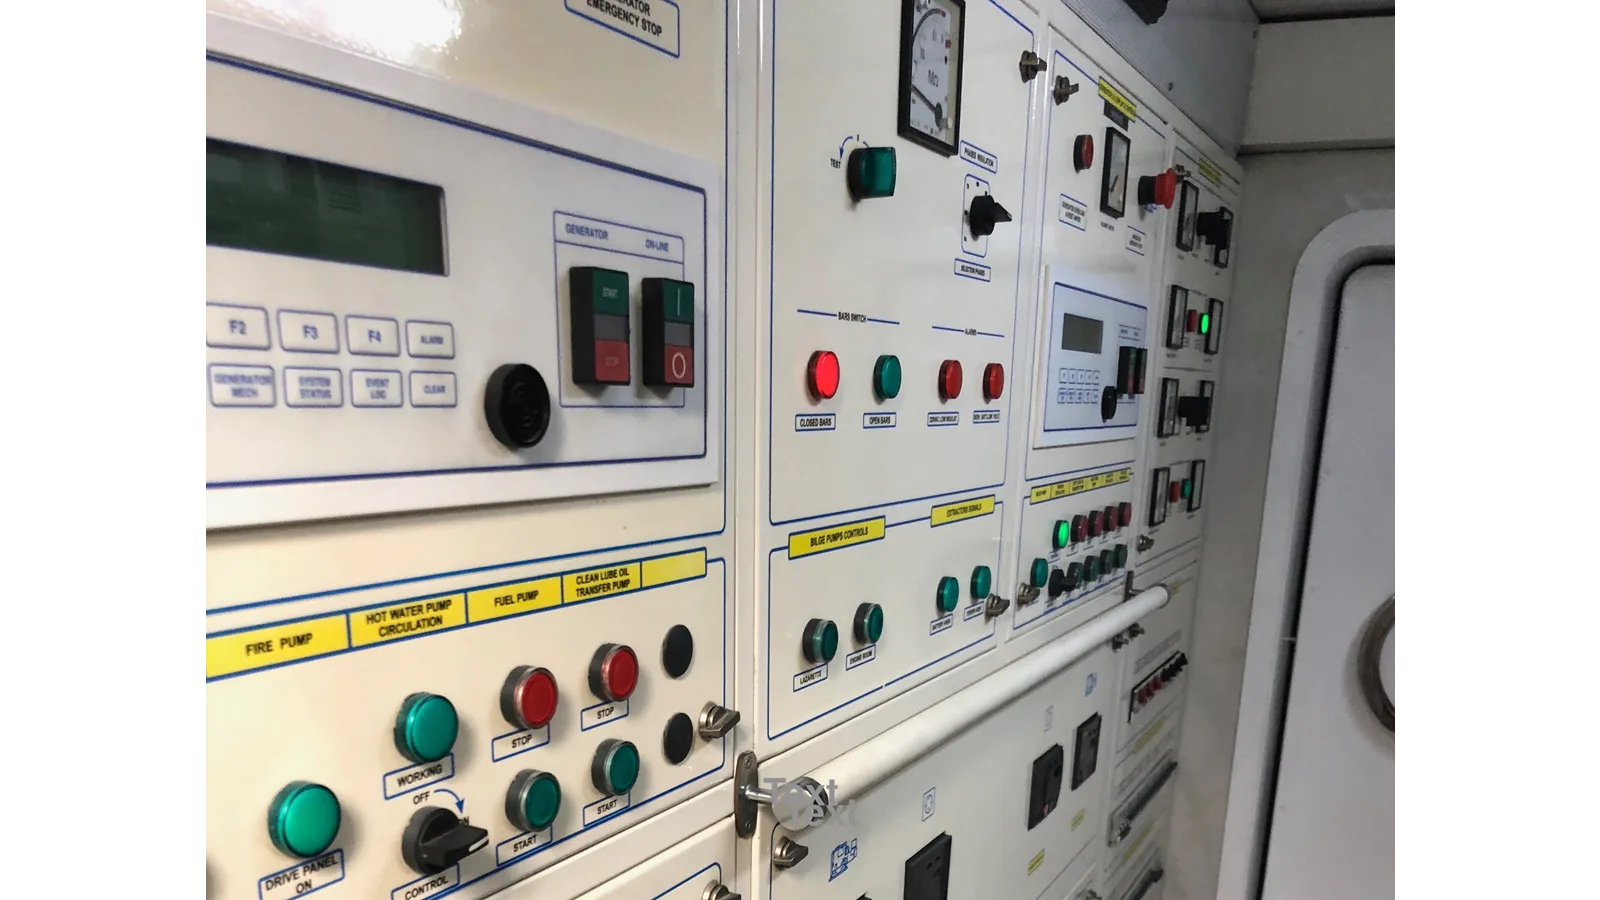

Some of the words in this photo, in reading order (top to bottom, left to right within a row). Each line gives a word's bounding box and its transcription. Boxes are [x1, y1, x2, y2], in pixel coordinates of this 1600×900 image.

[641, 18, 662, 37] STOP
[830, 158, 841, 169] TEST
[565, 223, 608, 239] GENERATOR
[645, 239, 669, 252] ON-LINE
[838, 311, 850, 321] BARS
[851, 313, 866, 323] SWITCH
[229, 319, 247, 335] F2
[302, 325, 318, 340] F3
[368, 329, 382, 344] F4
[366, 378, 389, 388] EVENT
[424, 385, 446, 394] CLEAR
[371, 390, 386, 399] LOG
[800, 418, 819, 428] CLOSED
[819, 417, 831, 426] BARS
[869, 416, 880, 425] OPEN
[880, 415, 891, 424] BARS
[810, 536, 825, 547] BILGE
[826, 533, 843, 544] PUMPS
[844, 526, 869, 540] CONTROLS
[576, 573, 599, 585] CLEAN
[600, 570, 617, 581] LUBE
[619, 567, 630, 577] OIL
[575, 582, 611, 598] TRANSFER
[612, 579, 630, 590] PUMP
[494, 595, 514, 607] FUEL
[516, 590, 539, 603] PUMP
[366, 610, 387, 625] HOT
[390, 605, 424, 620] WATER
[426, 599, 452, 613] PUMP
[378, 615, 443, 637] CIRCULATION
[245, 640, 273, 656] FIRE
[280, 632, 313, 650] PUMP
[597, 707, 614, 719] STOP
[511, 734, 532, 748] STOP
[397, 764, 443, 788] WORKING
[412, 791, 430, 805] OFF
[597, 799, 617, 814] START
[513, 835, 537, 852] START
[265, 871, 300, 891] DRIVE
[302, 855, 338, 879] PANEL
[296, 880, 312, 895] ON
[404, 876, 449, 900] CONTROL
